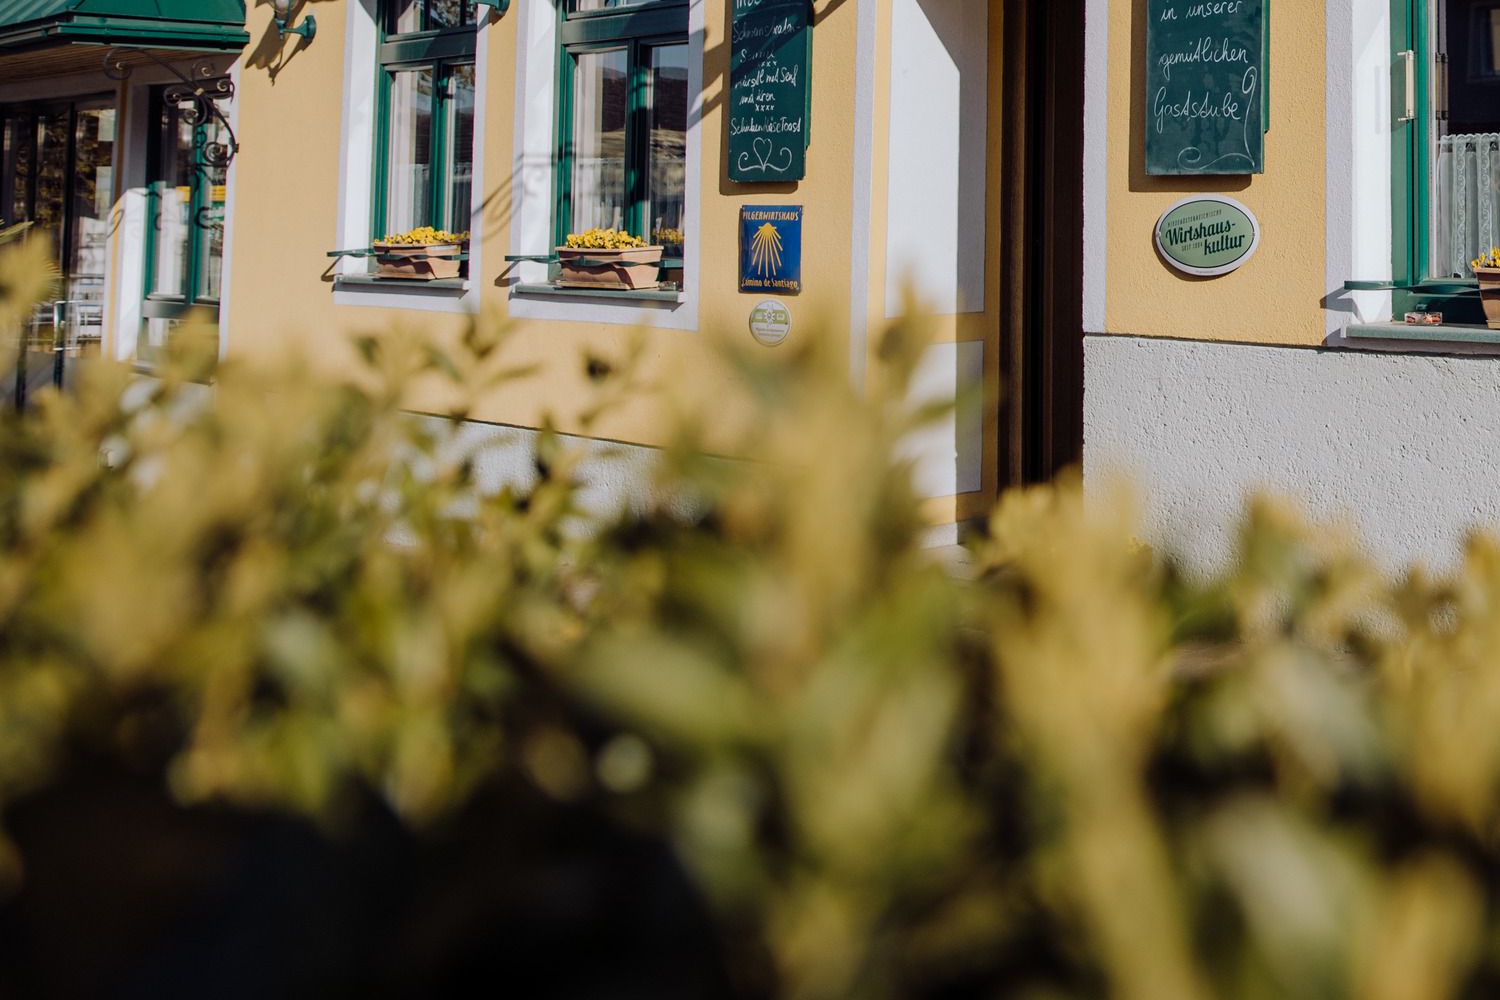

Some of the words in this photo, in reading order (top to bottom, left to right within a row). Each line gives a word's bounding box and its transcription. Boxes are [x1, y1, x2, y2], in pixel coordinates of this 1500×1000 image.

[1160, 0, 1178, 22] in
[1185, 0, 1243, 20] unserer
[1158, 36, 1249, 81] gemütlichen
[1153, 86, 1241, 134] Gaststube
[742, 211, 799, 221] PILGERWIRTSHAUS
[1165, 219, 1236, 246] Wirtshaus-
[1203, 234, 1245, 256] kultur
[763, 278, 771, 288] de
[771, 278, 798, 289] Santiago
